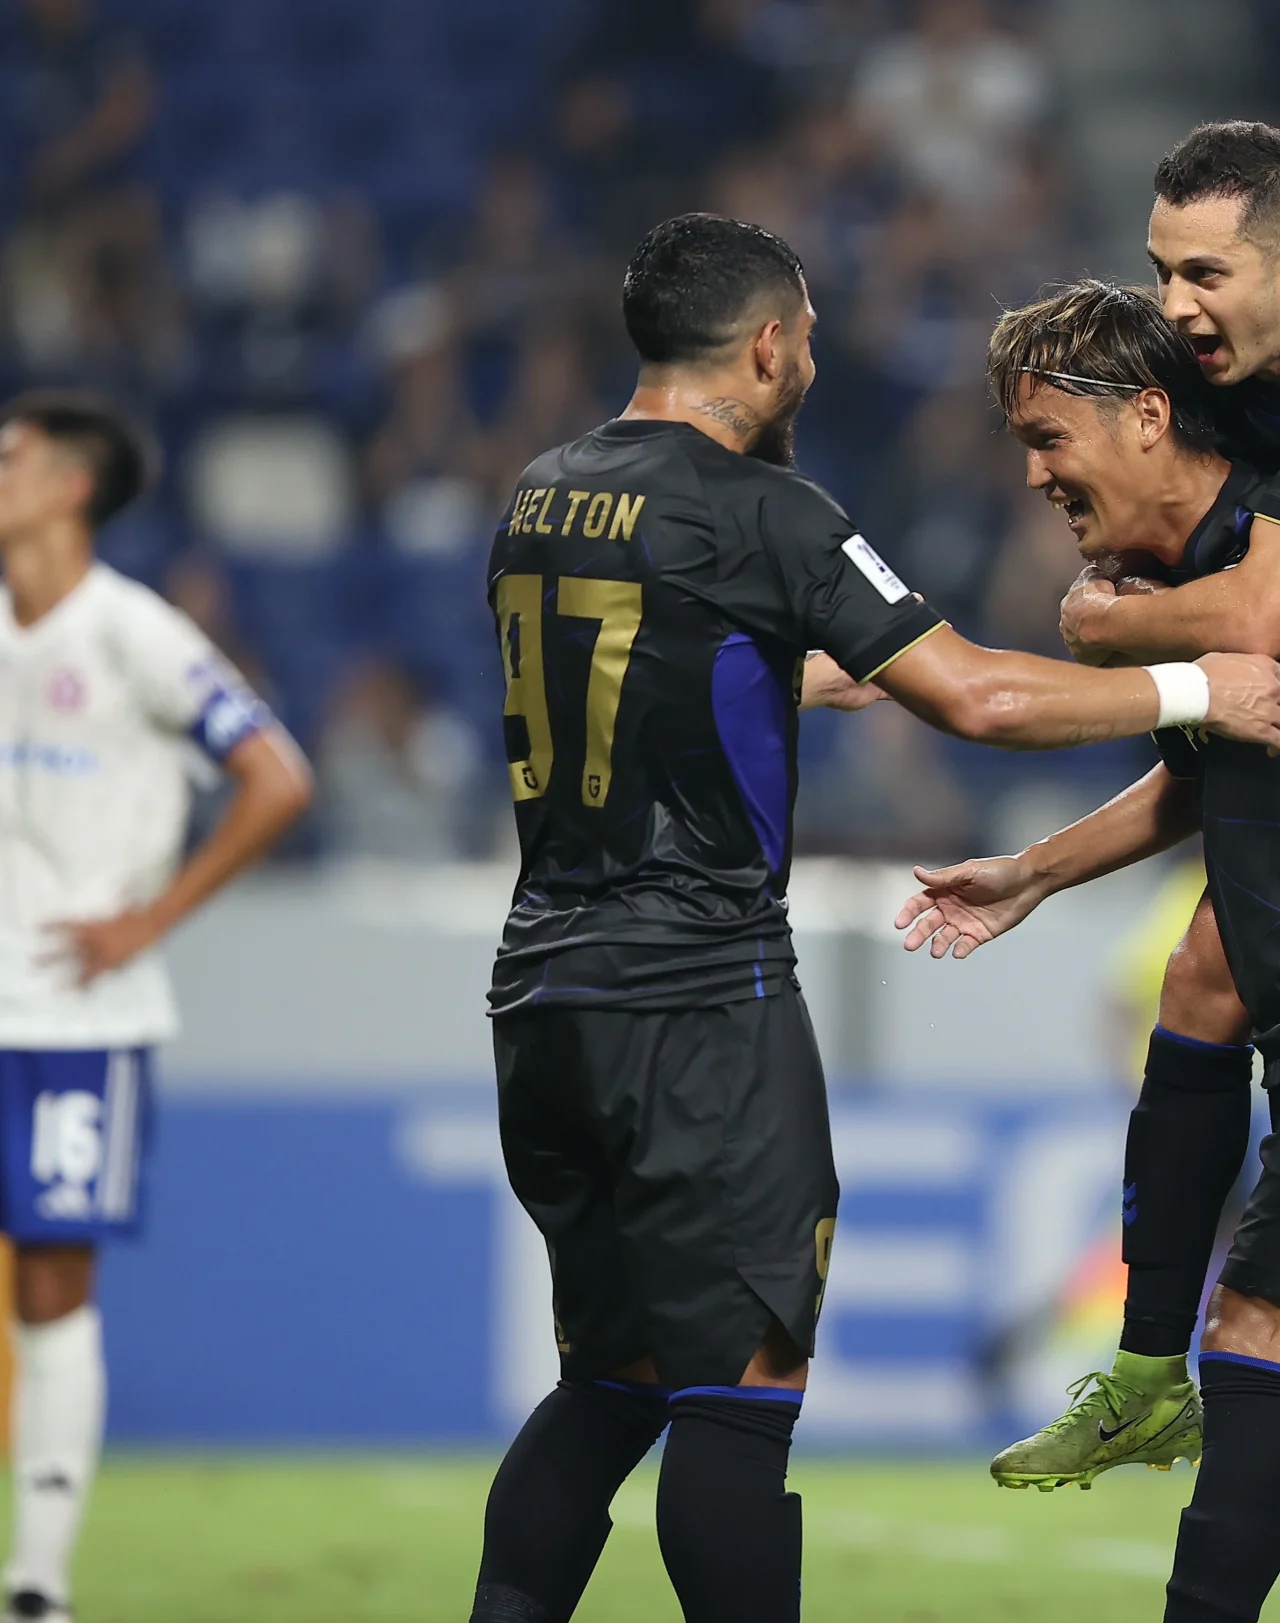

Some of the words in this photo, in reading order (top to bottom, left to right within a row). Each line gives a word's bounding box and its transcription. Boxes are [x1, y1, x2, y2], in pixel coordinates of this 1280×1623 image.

[507, 487, 646, 541] HELTON
[495, 573, 643, 808] 97
[29, 1088, 103, 1186] 16
